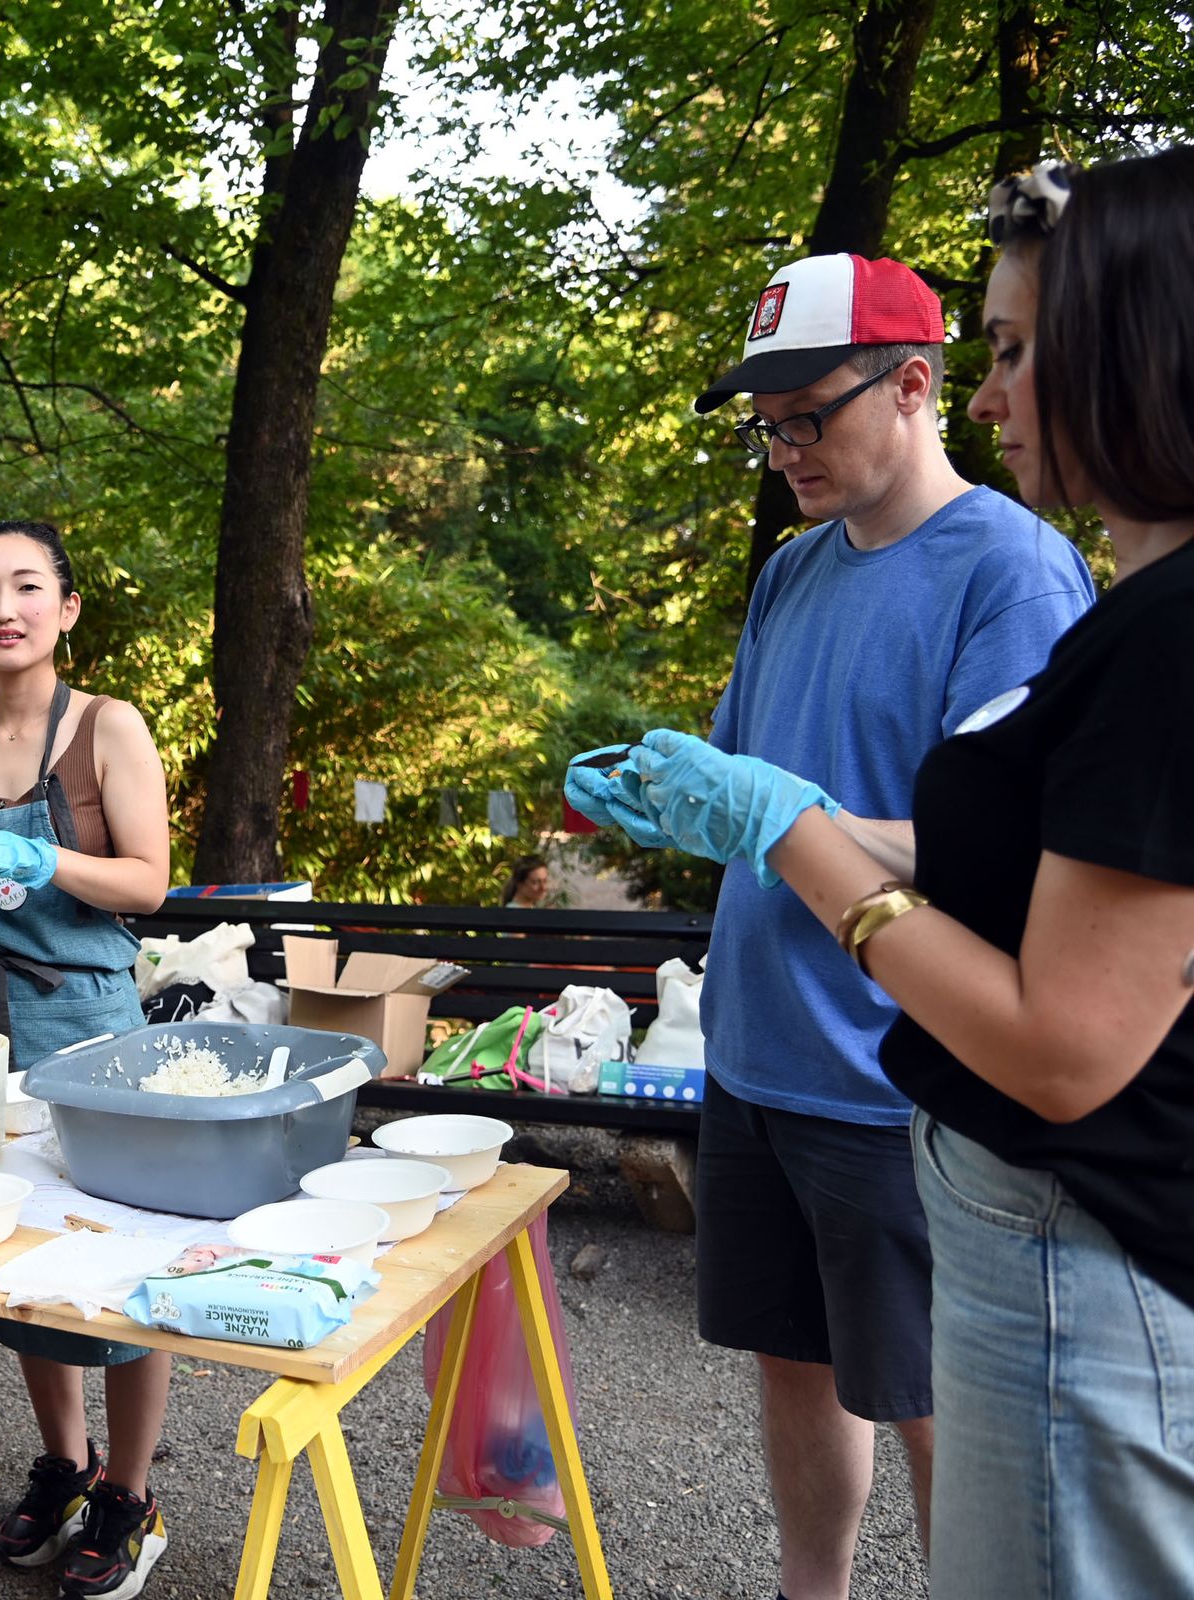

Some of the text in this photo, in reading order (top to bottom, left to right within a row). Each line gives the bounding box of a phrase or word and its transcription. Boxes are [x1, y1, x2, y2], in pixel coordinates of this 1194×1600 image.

[167, 1266, 184, 1274] 80
[205, 1310, 269, 1327] MARAMICE
[224, 1322, 270, 1338] VLAŽNE
